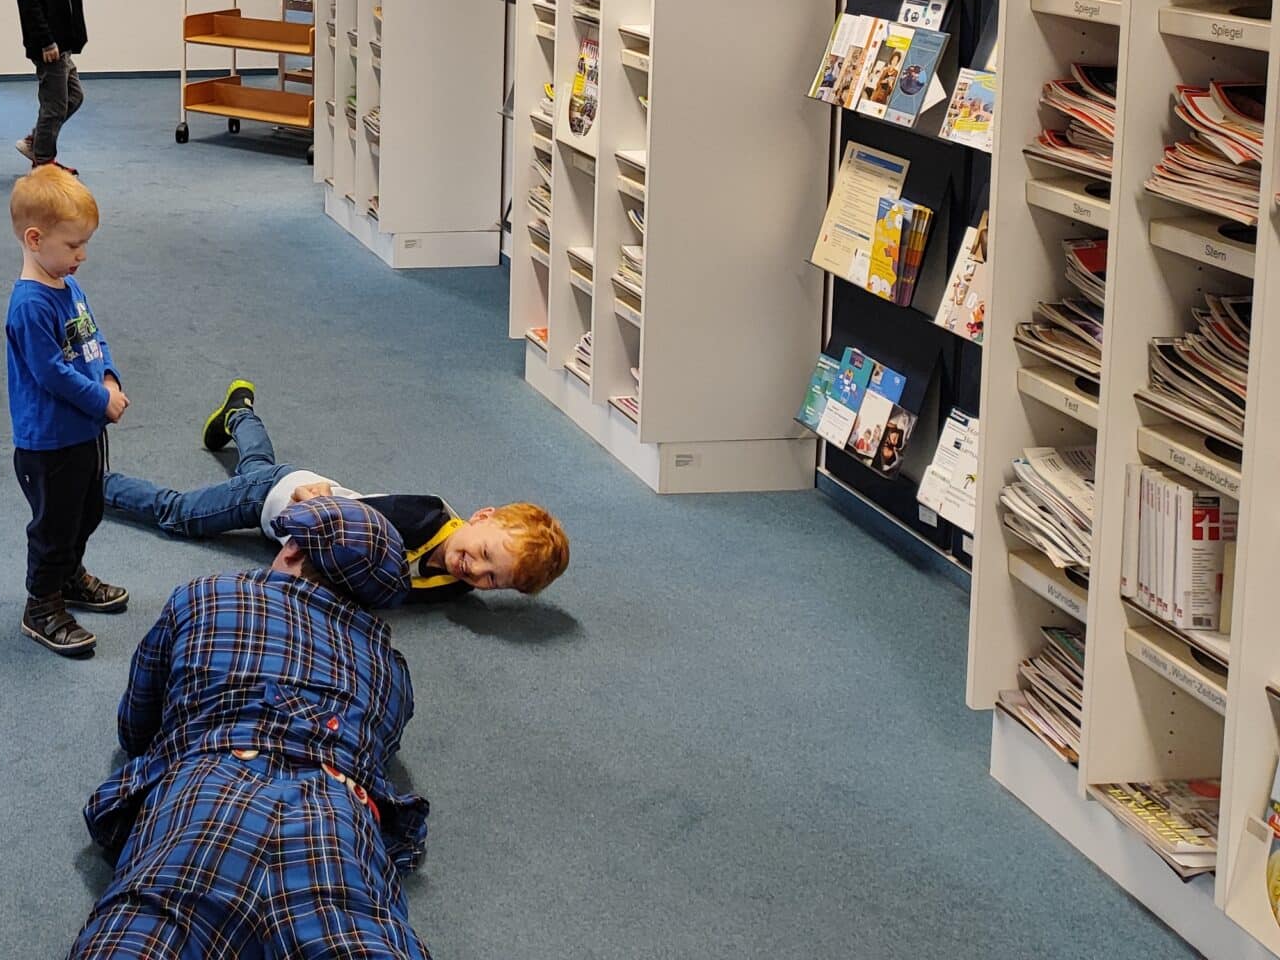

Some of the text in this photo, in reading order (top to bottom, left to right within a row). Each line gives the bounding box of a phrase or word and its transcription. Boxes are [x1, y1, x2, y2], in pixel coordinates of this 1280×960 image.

[1073, 0, 1101, 18] Spiegel
[1210, 22, 1244, 42] Spiegel
[1072, 203, 1092, 219] Stern
[1204, 244, 1227, 262] Stern
[1063, 396, 1080, 413] Test
[1168, 447, 1184, 464] Test
